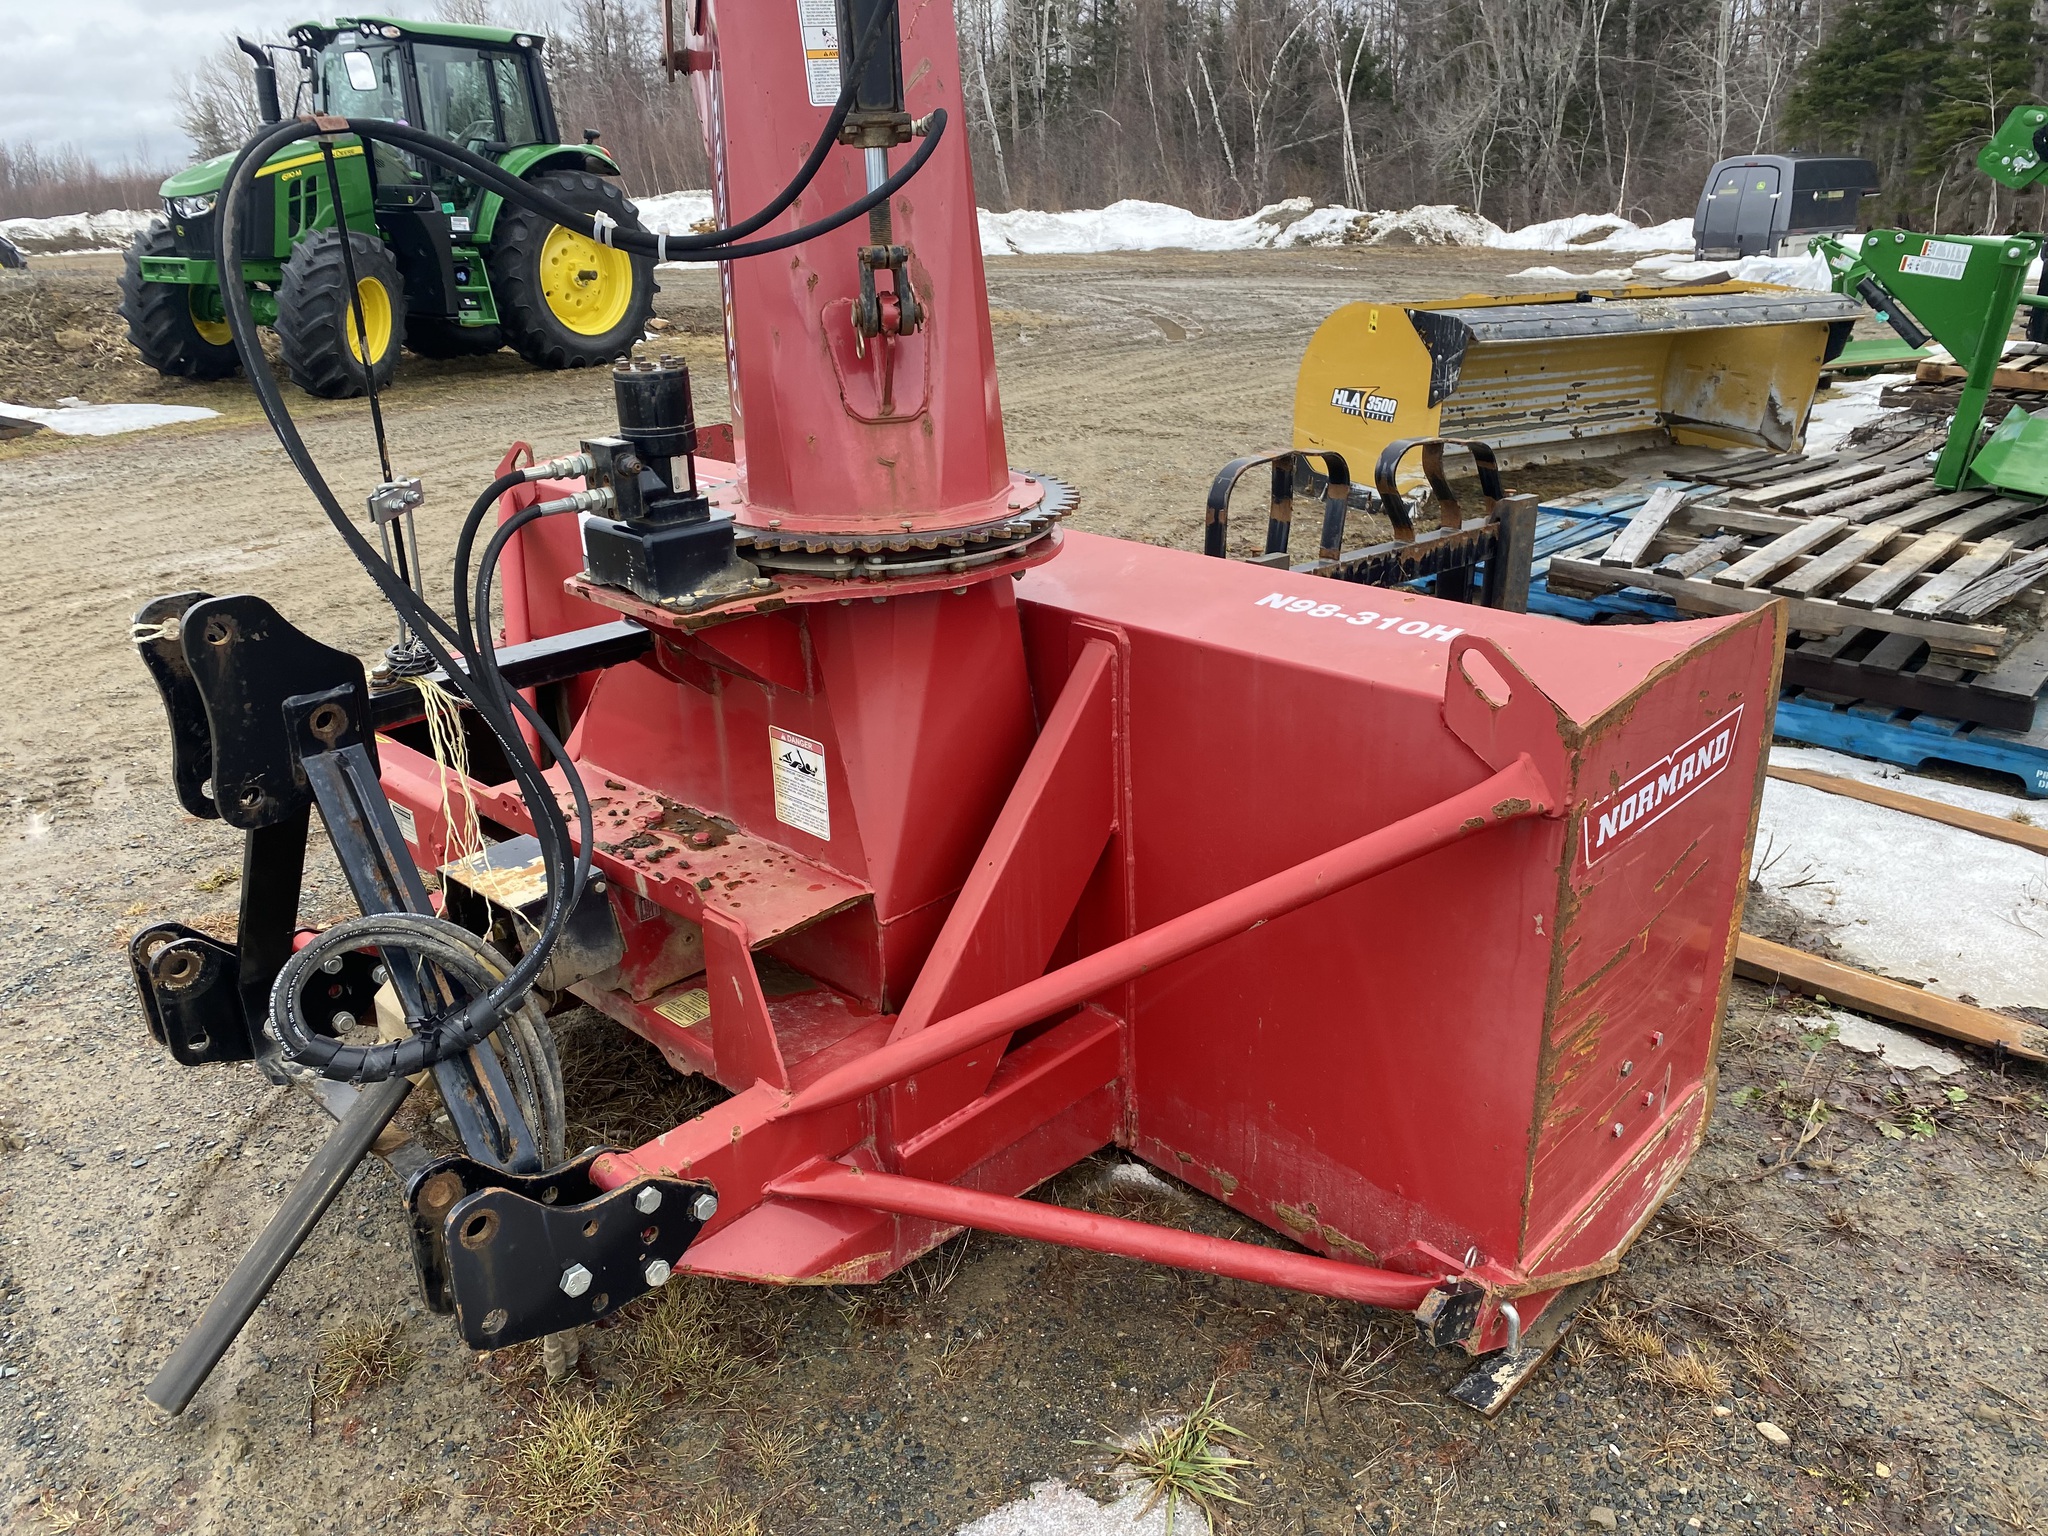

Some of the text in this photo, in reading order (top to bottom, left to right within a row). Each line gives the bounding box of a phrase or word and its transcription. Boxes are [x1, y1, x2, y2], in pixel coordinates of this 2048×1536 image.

[1331, 389, 1397, 414] HLA 3500
[1254, 592, 1465, 642] N98-310H
[786, 734, 813, 750] DANGER
[1596, 728, 1730, 848] NORMAND
